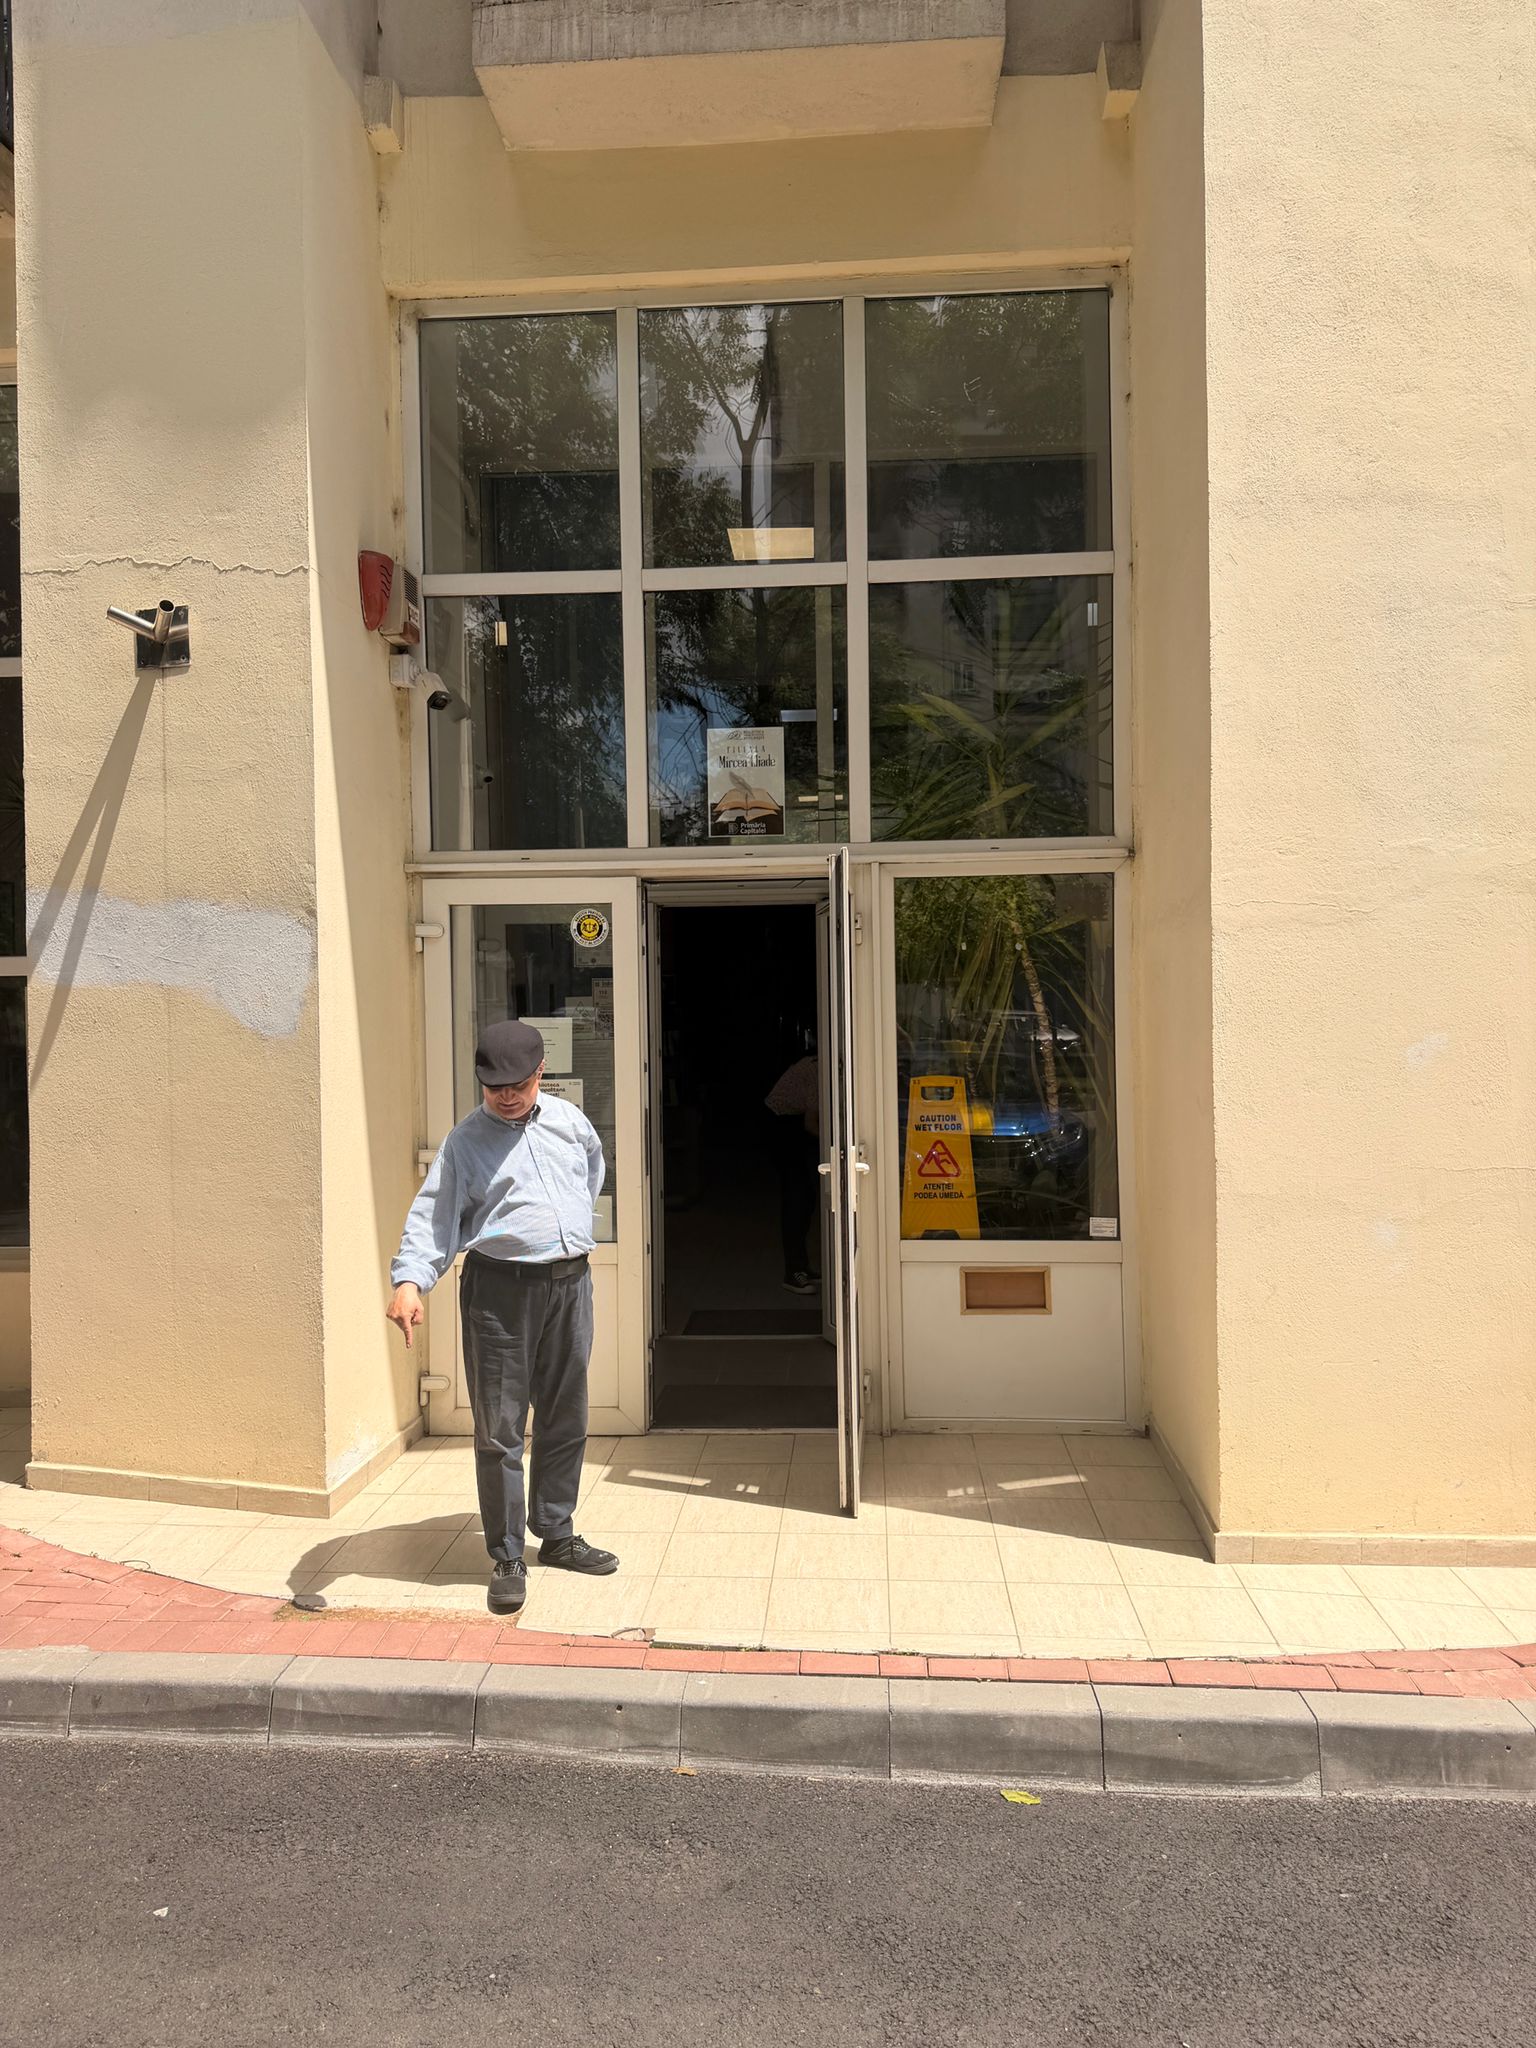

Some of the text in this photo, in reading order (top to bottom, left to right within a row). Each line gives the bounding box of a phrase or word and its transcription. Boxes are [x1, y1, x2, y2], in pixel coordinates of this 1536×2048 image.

[719, 755, 747, 769] Mircea
[920, 1114, 956, 1122] CAUTION
[914, 1123, 962, 1131] WET FLOOR
